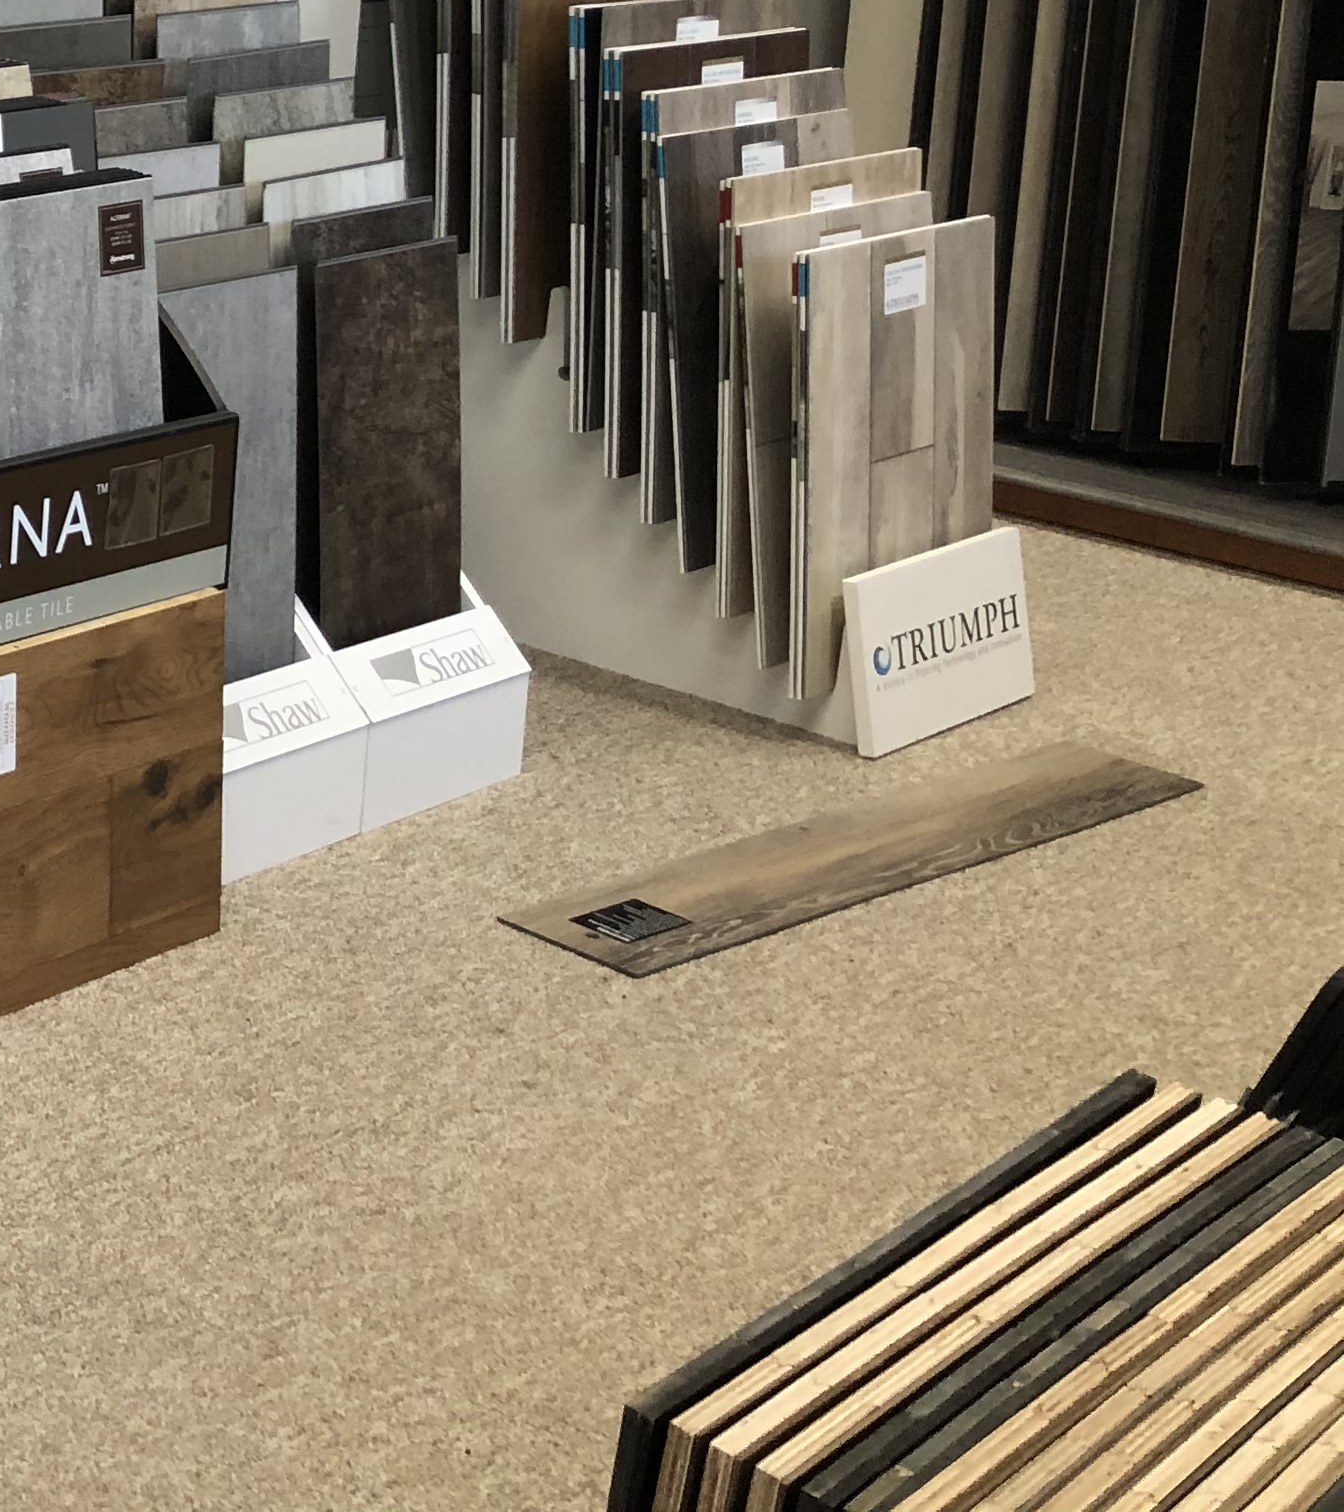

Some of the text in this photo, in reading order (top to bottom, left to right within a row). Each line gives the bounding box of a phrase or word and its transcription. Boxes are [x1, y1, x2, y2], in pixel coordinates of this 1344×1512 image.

[40, 595, 75, 618] TILE
[890, 593, 1021, 671] TRIUMPH
[418, 643, 489, 685] Shaw
[246, 696, 323, 741] Shaw
